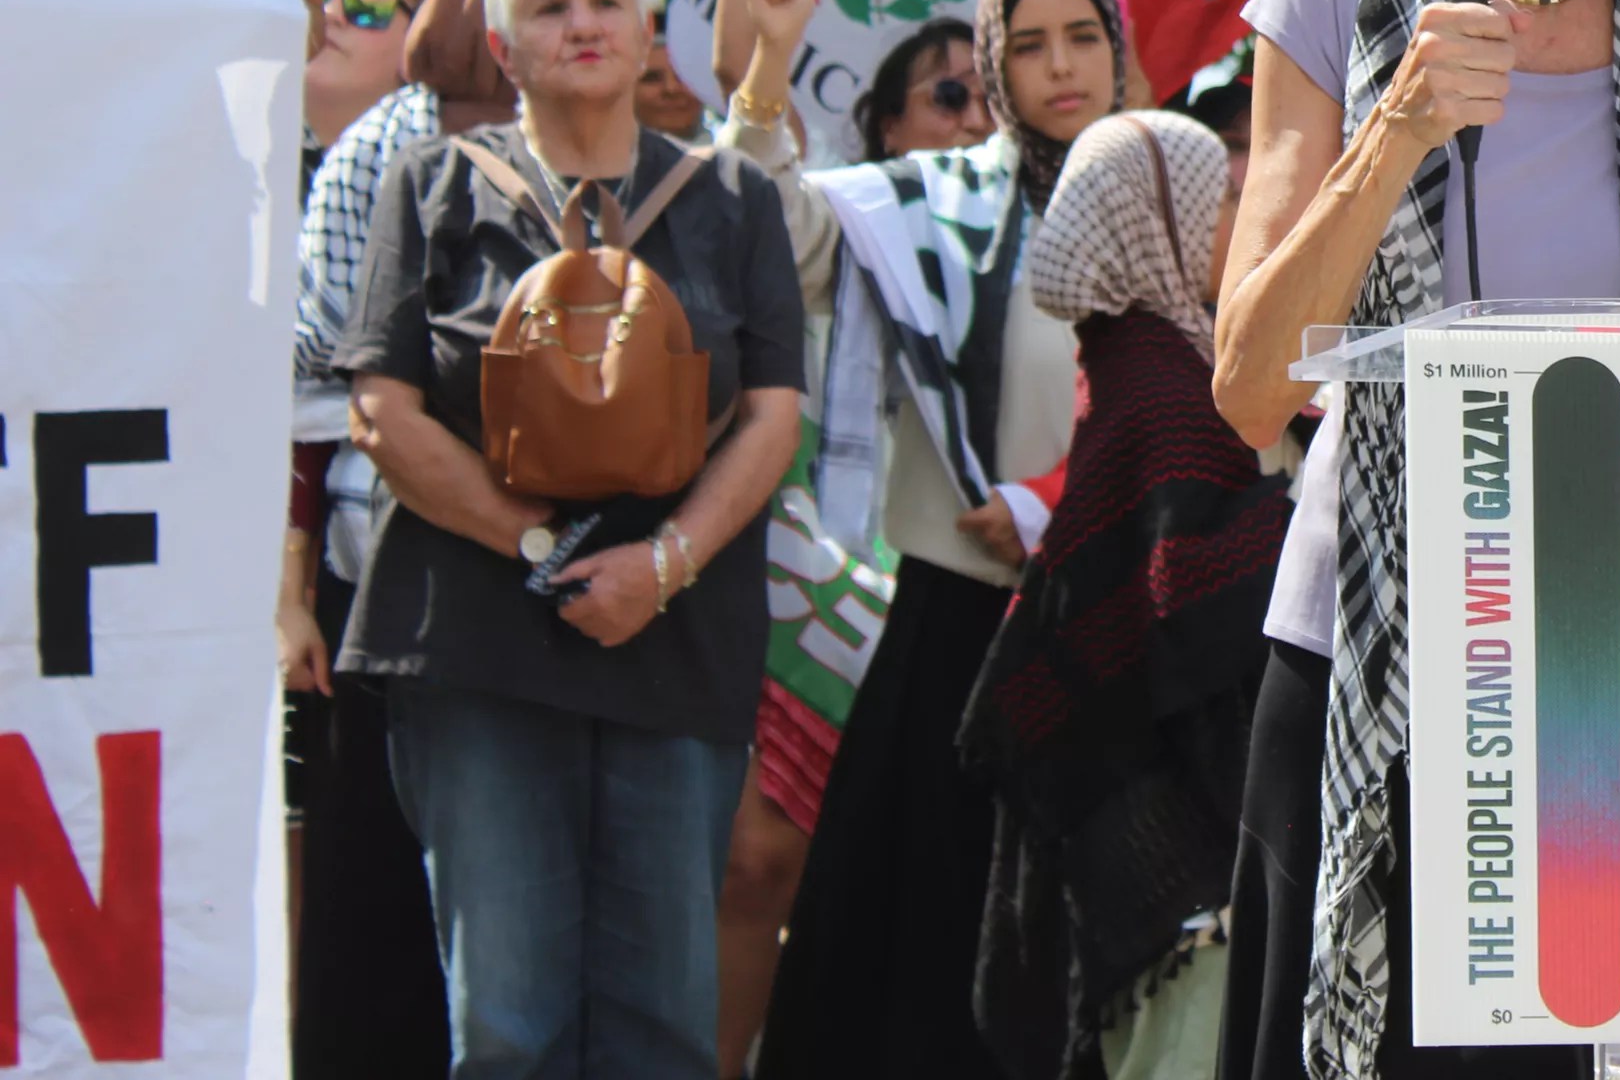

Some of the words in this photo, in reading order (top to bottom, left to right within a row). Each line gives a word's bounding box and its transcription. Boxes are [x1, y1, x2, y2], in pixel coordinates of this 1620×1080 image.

[1423, 363, 1443, 379] $1
[1450, 363, 1508, 379] Million
[1462, 389, 1511, 521] GAZA!
[1464, 531, 1512, 627] WITH
[1465, 638, 1513, 758] STAND
[1466, 769, 1514, 904] PEOPLE
[1466, 916, 1515, 986] THE
[1491, 1009, 1513, 1024] $0
